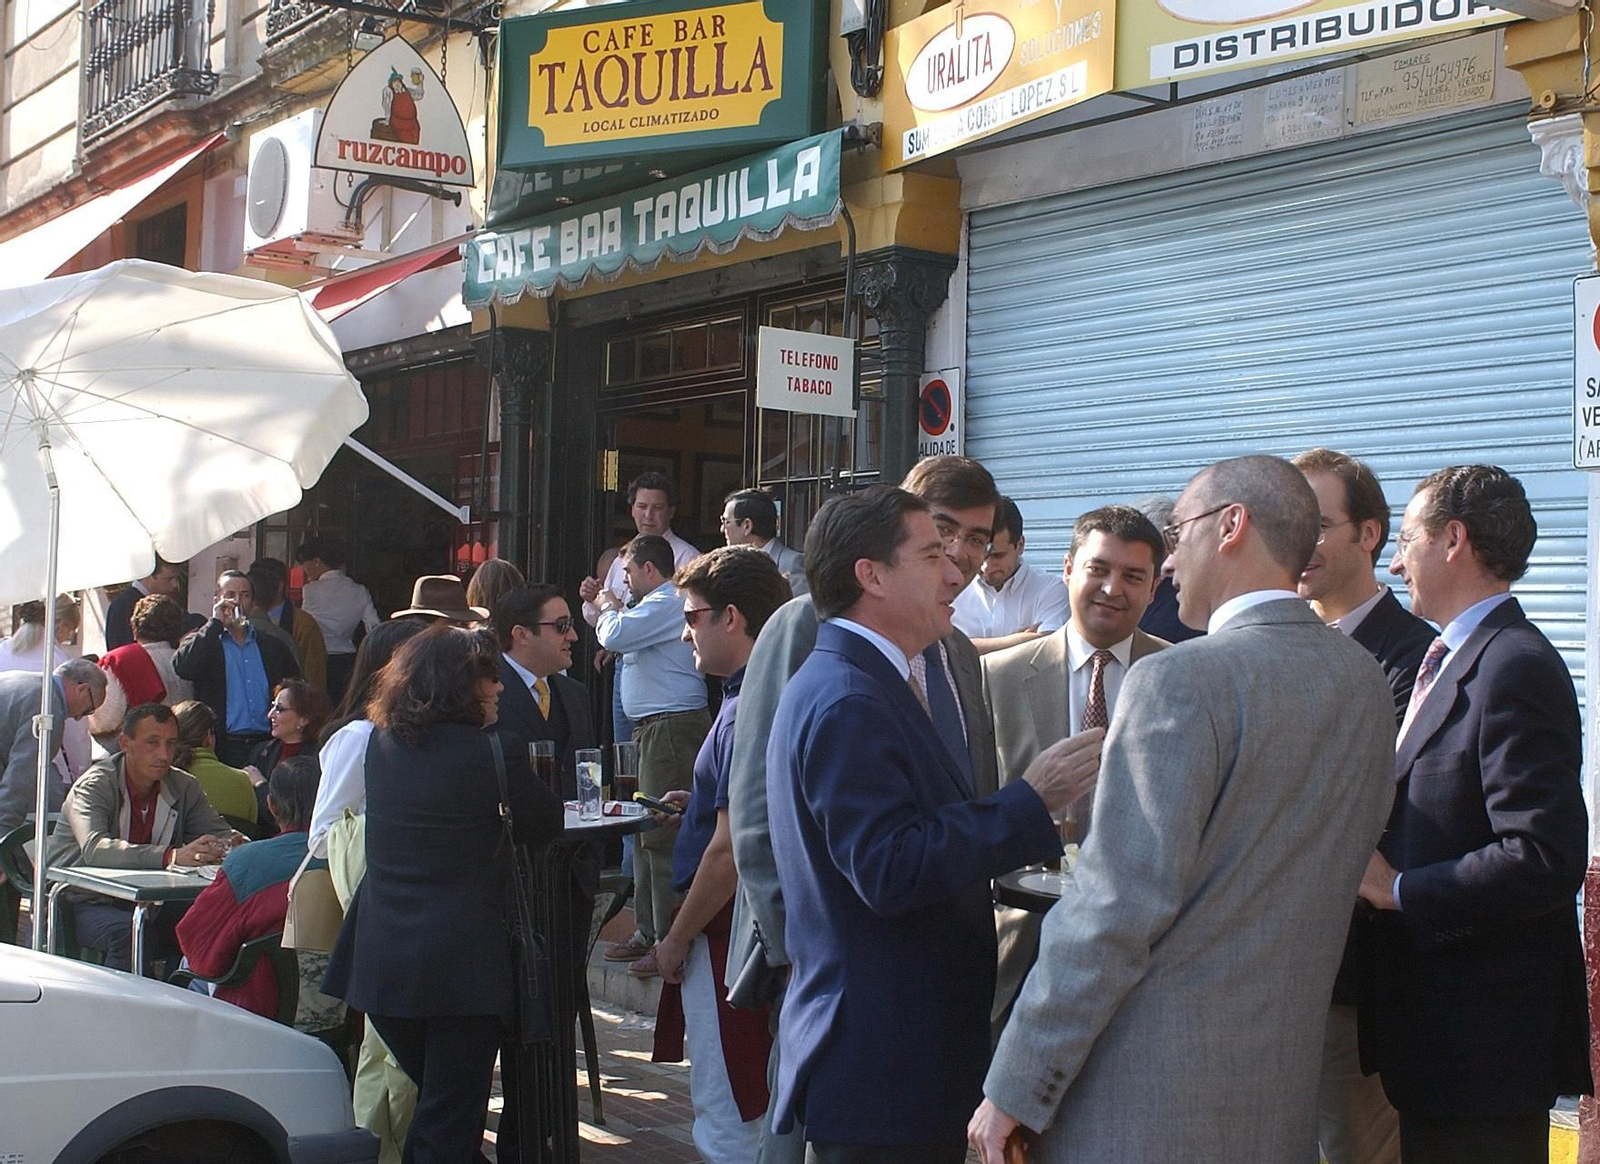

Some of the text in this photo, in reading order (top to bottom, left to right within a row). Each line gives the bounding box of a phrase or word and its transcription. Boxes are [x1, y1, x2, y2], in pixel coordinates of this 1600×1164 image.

[583, 14, 727, 54] CAFE BAR
[538, 36, 774, 116] TAQUILLA
[927, 31, 993, 94] URALITA
[582, 108, 720, 134] LOCAL CLIMATIZADO
[476, 224, 553, 284] CAFE
[560, 206, 622, 265] BAR
[633, 145, 823, 246] TAQUILLA
[780, 348, 839, 371] TELEFONO
[786, 376, 833, 396] TABACO
[918, 439, 956, 456] ALIDA DE
